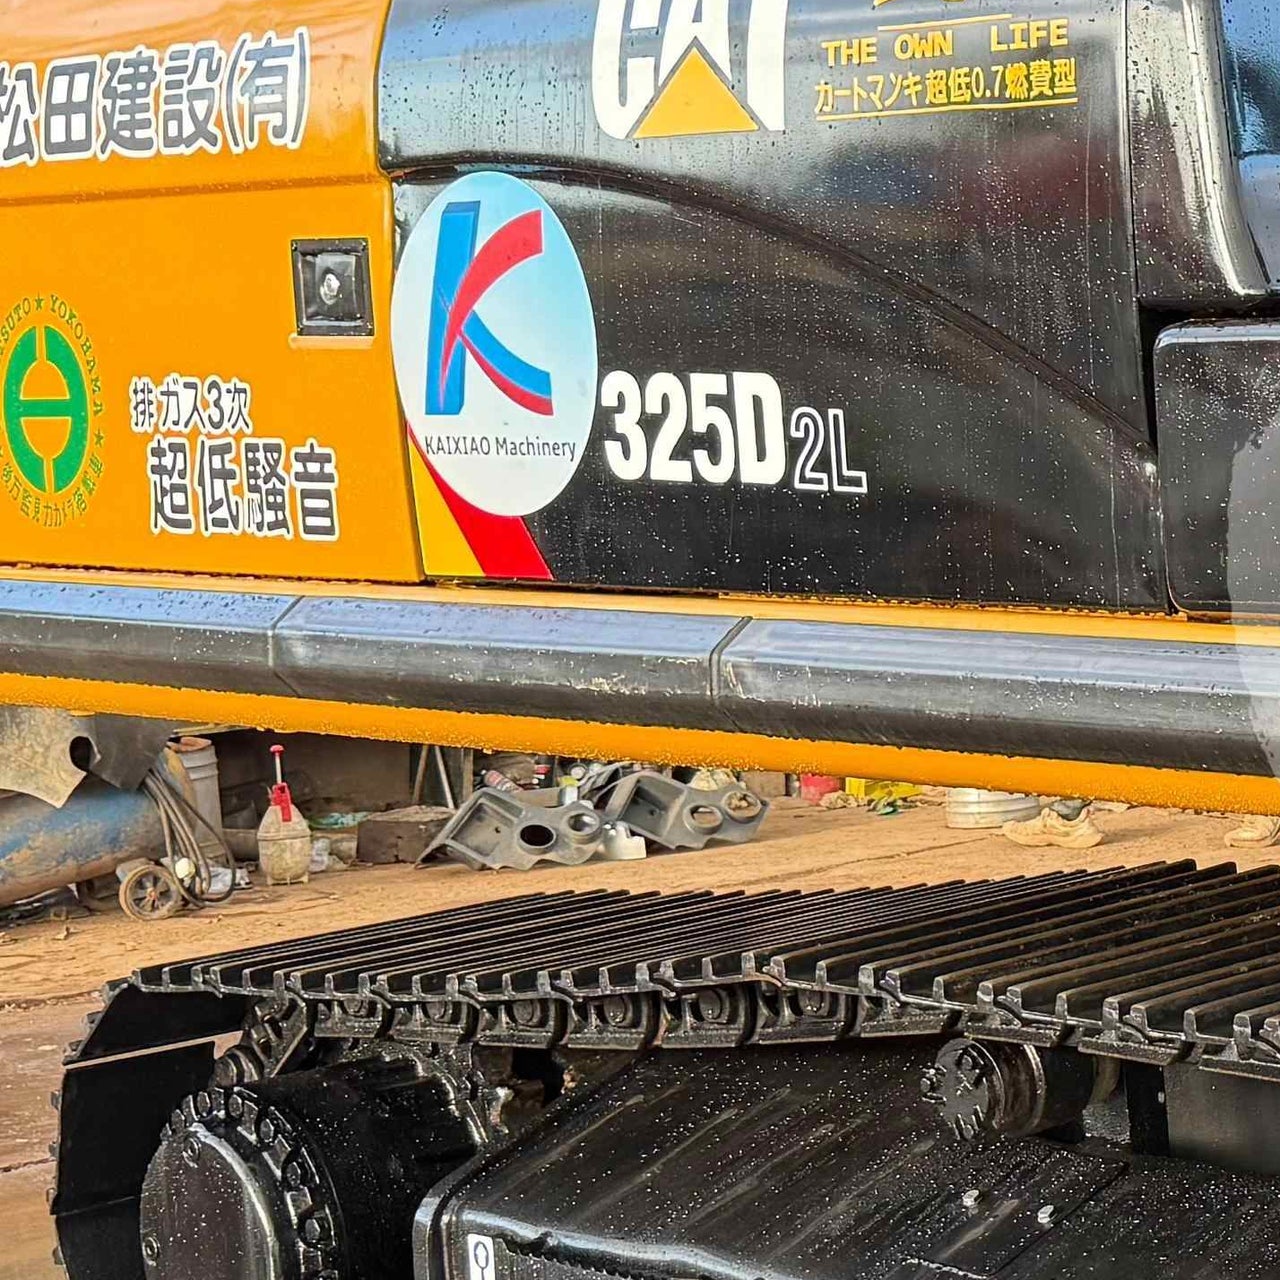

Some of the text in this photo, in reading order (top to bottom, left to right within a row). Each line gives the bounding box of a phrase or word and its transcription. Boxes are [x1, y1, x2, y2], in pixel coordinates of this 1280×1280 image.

[821, 18, 1069, 67] THE OWN LIFE
[131, 375, 252, 432] 排ガス3次
[425, 436, 576, 462] KAIXIAO Machinery
[600, 370, 868, 493] 325D 2L
